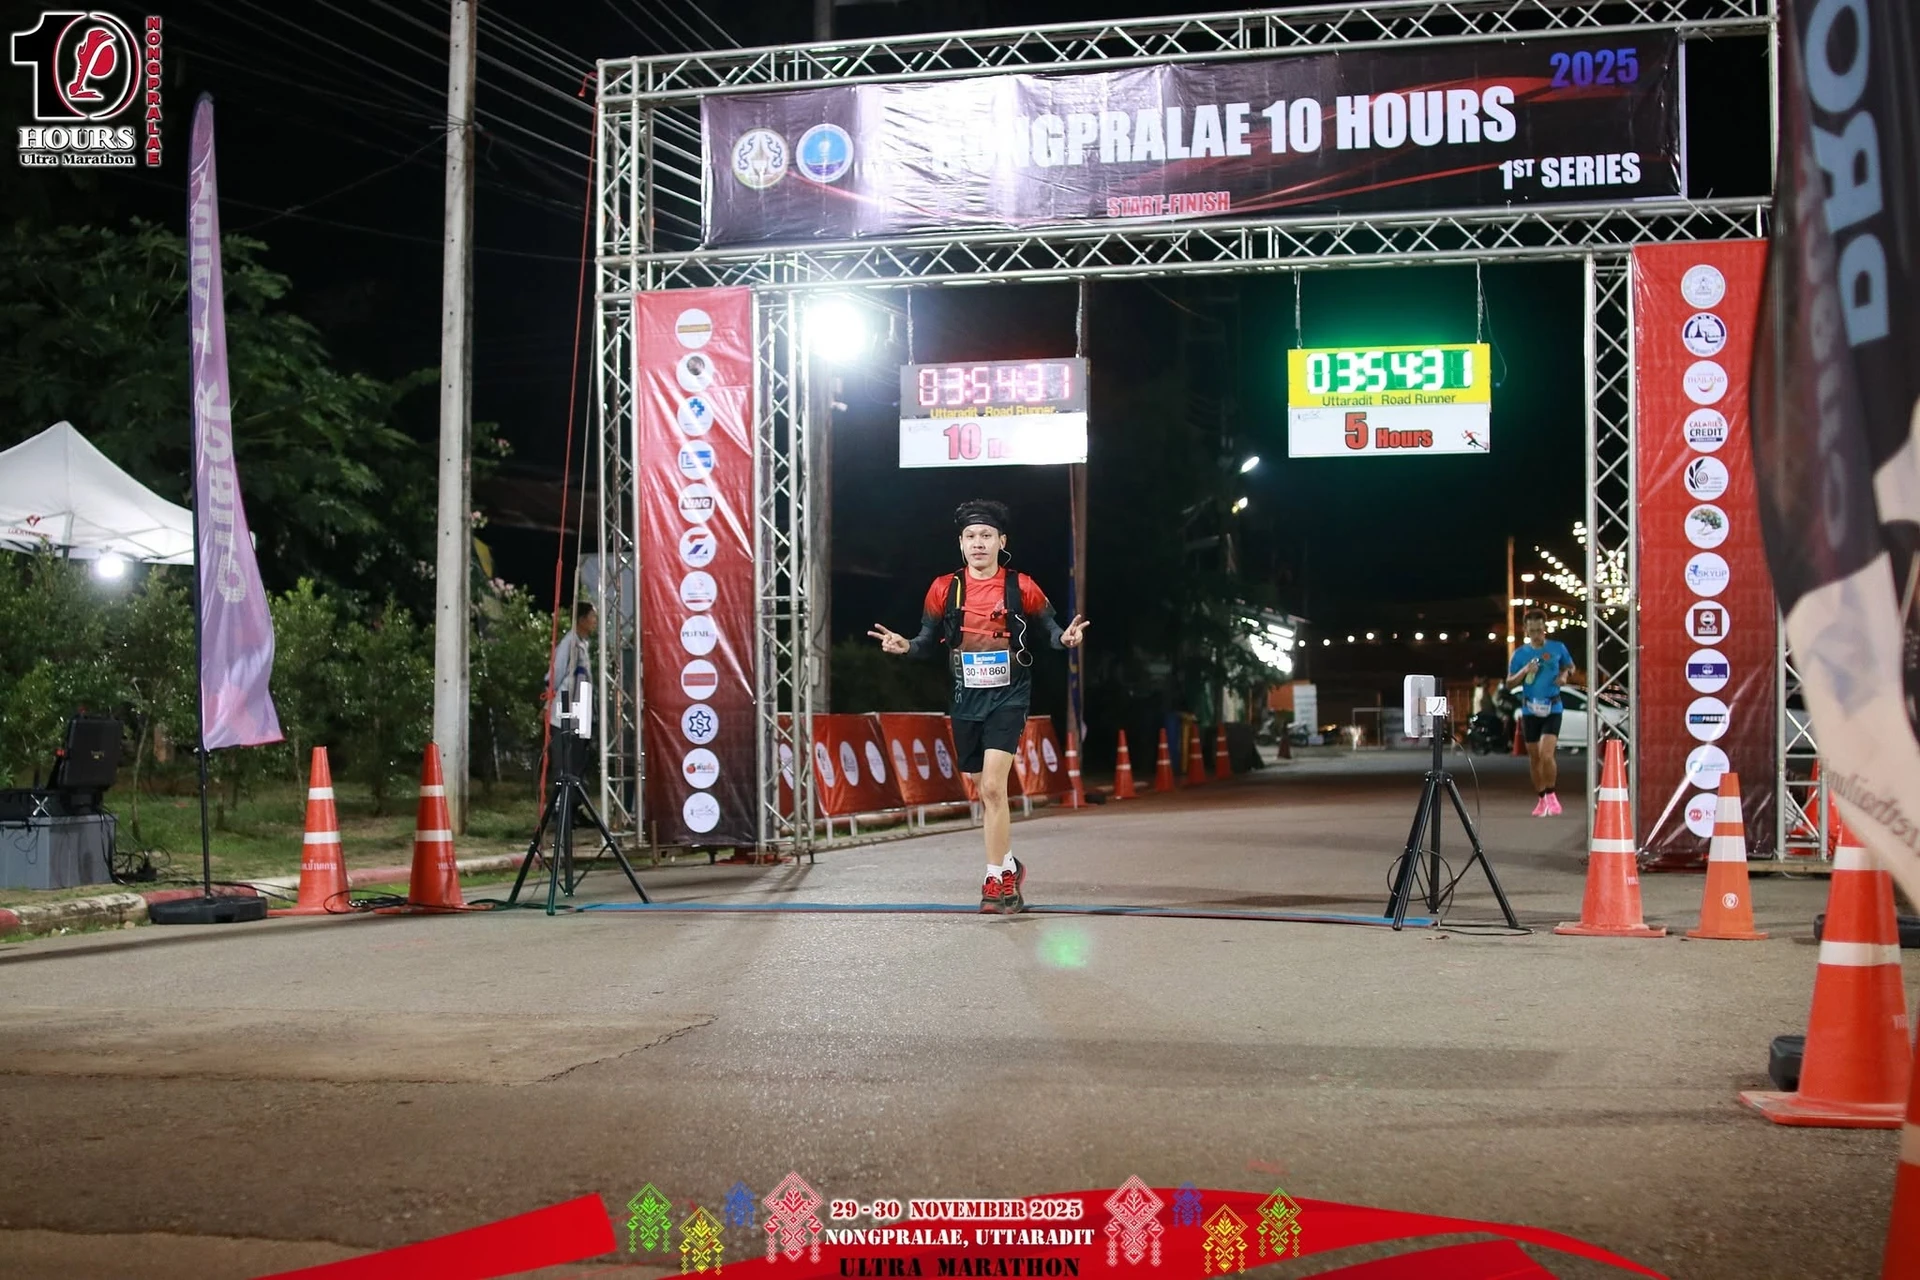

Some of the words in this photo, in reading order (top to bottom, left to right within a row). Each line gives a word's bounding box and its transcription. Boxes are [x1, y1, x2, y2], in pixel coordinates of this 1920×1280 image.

[1549, 48, 1640, 88] 2025
[1262, 97, 1322, 153] 10
[1336, 85, 1517, 150] HOURS
[1500, 158, 1535, 190] 1ST
[1541, 152, 1641, 188] SERIES
[1107, 191, 1231, 218] START-FINISH
[930, 407, 978, 418] Uttaradit
[984, 406, 1014, 416] Road
[1017, 405, 1056, 415] Runner
[1322, 395, 1373, 406] Uttaradit
[1381, 394, 1411, 405] Road
[1415, 393, 1456, 404] Runner
[943, 423, 982, 460] 10
[1345, 412, 1368, 449] 5
[1375, 428, 1433, 449] Hours
[1689, 428, 1723, 437] CREDIT
